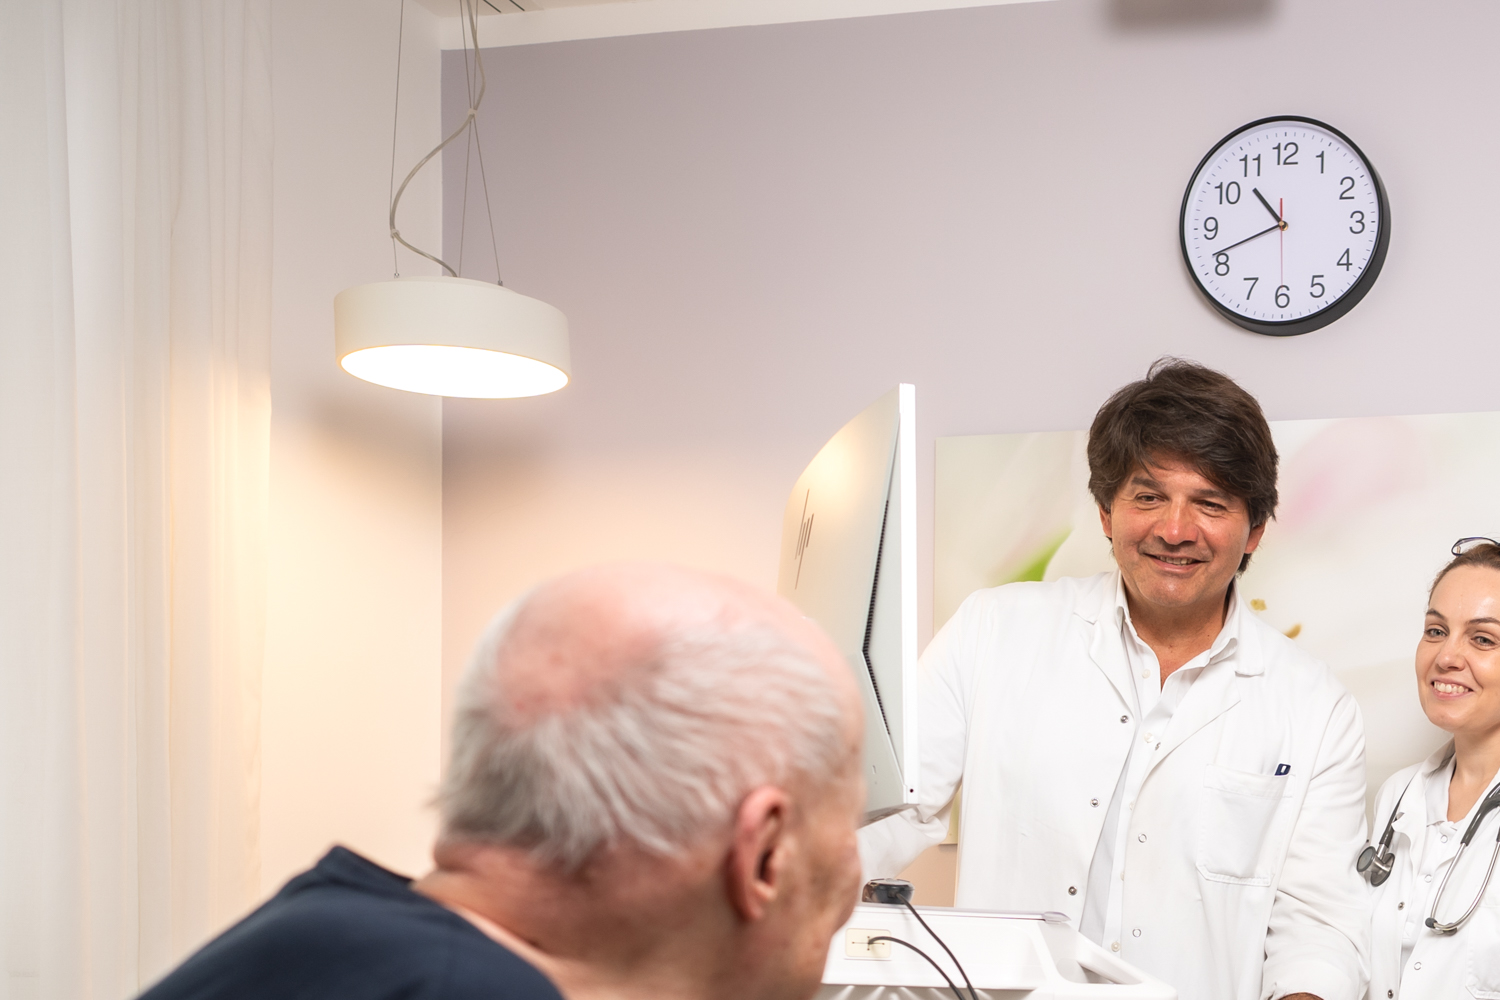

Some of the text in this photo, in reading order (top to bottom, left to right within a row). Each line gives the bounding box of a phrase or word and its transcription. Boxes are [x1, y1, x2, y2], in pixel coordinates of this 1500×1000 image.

[1239, 153, 1261, 177] 11
[1272, 142, 1299, 165] 12
[1315, 151, 1325, 174] 1
[1214, 181, 1241, 205] 10
[1339, 176, 1355, 200] 2
[1203, 217, 1219, 240] 9
[1349, 211, 1365, 234] 3
[1214, 252, 1230, 276] 8
[1336, 248, 1353, 271] 4
[1243, 277, 1259, 300] 7
[1275, 285, 1290, 308] 6
[1309, 275, 1325, 298] 5
